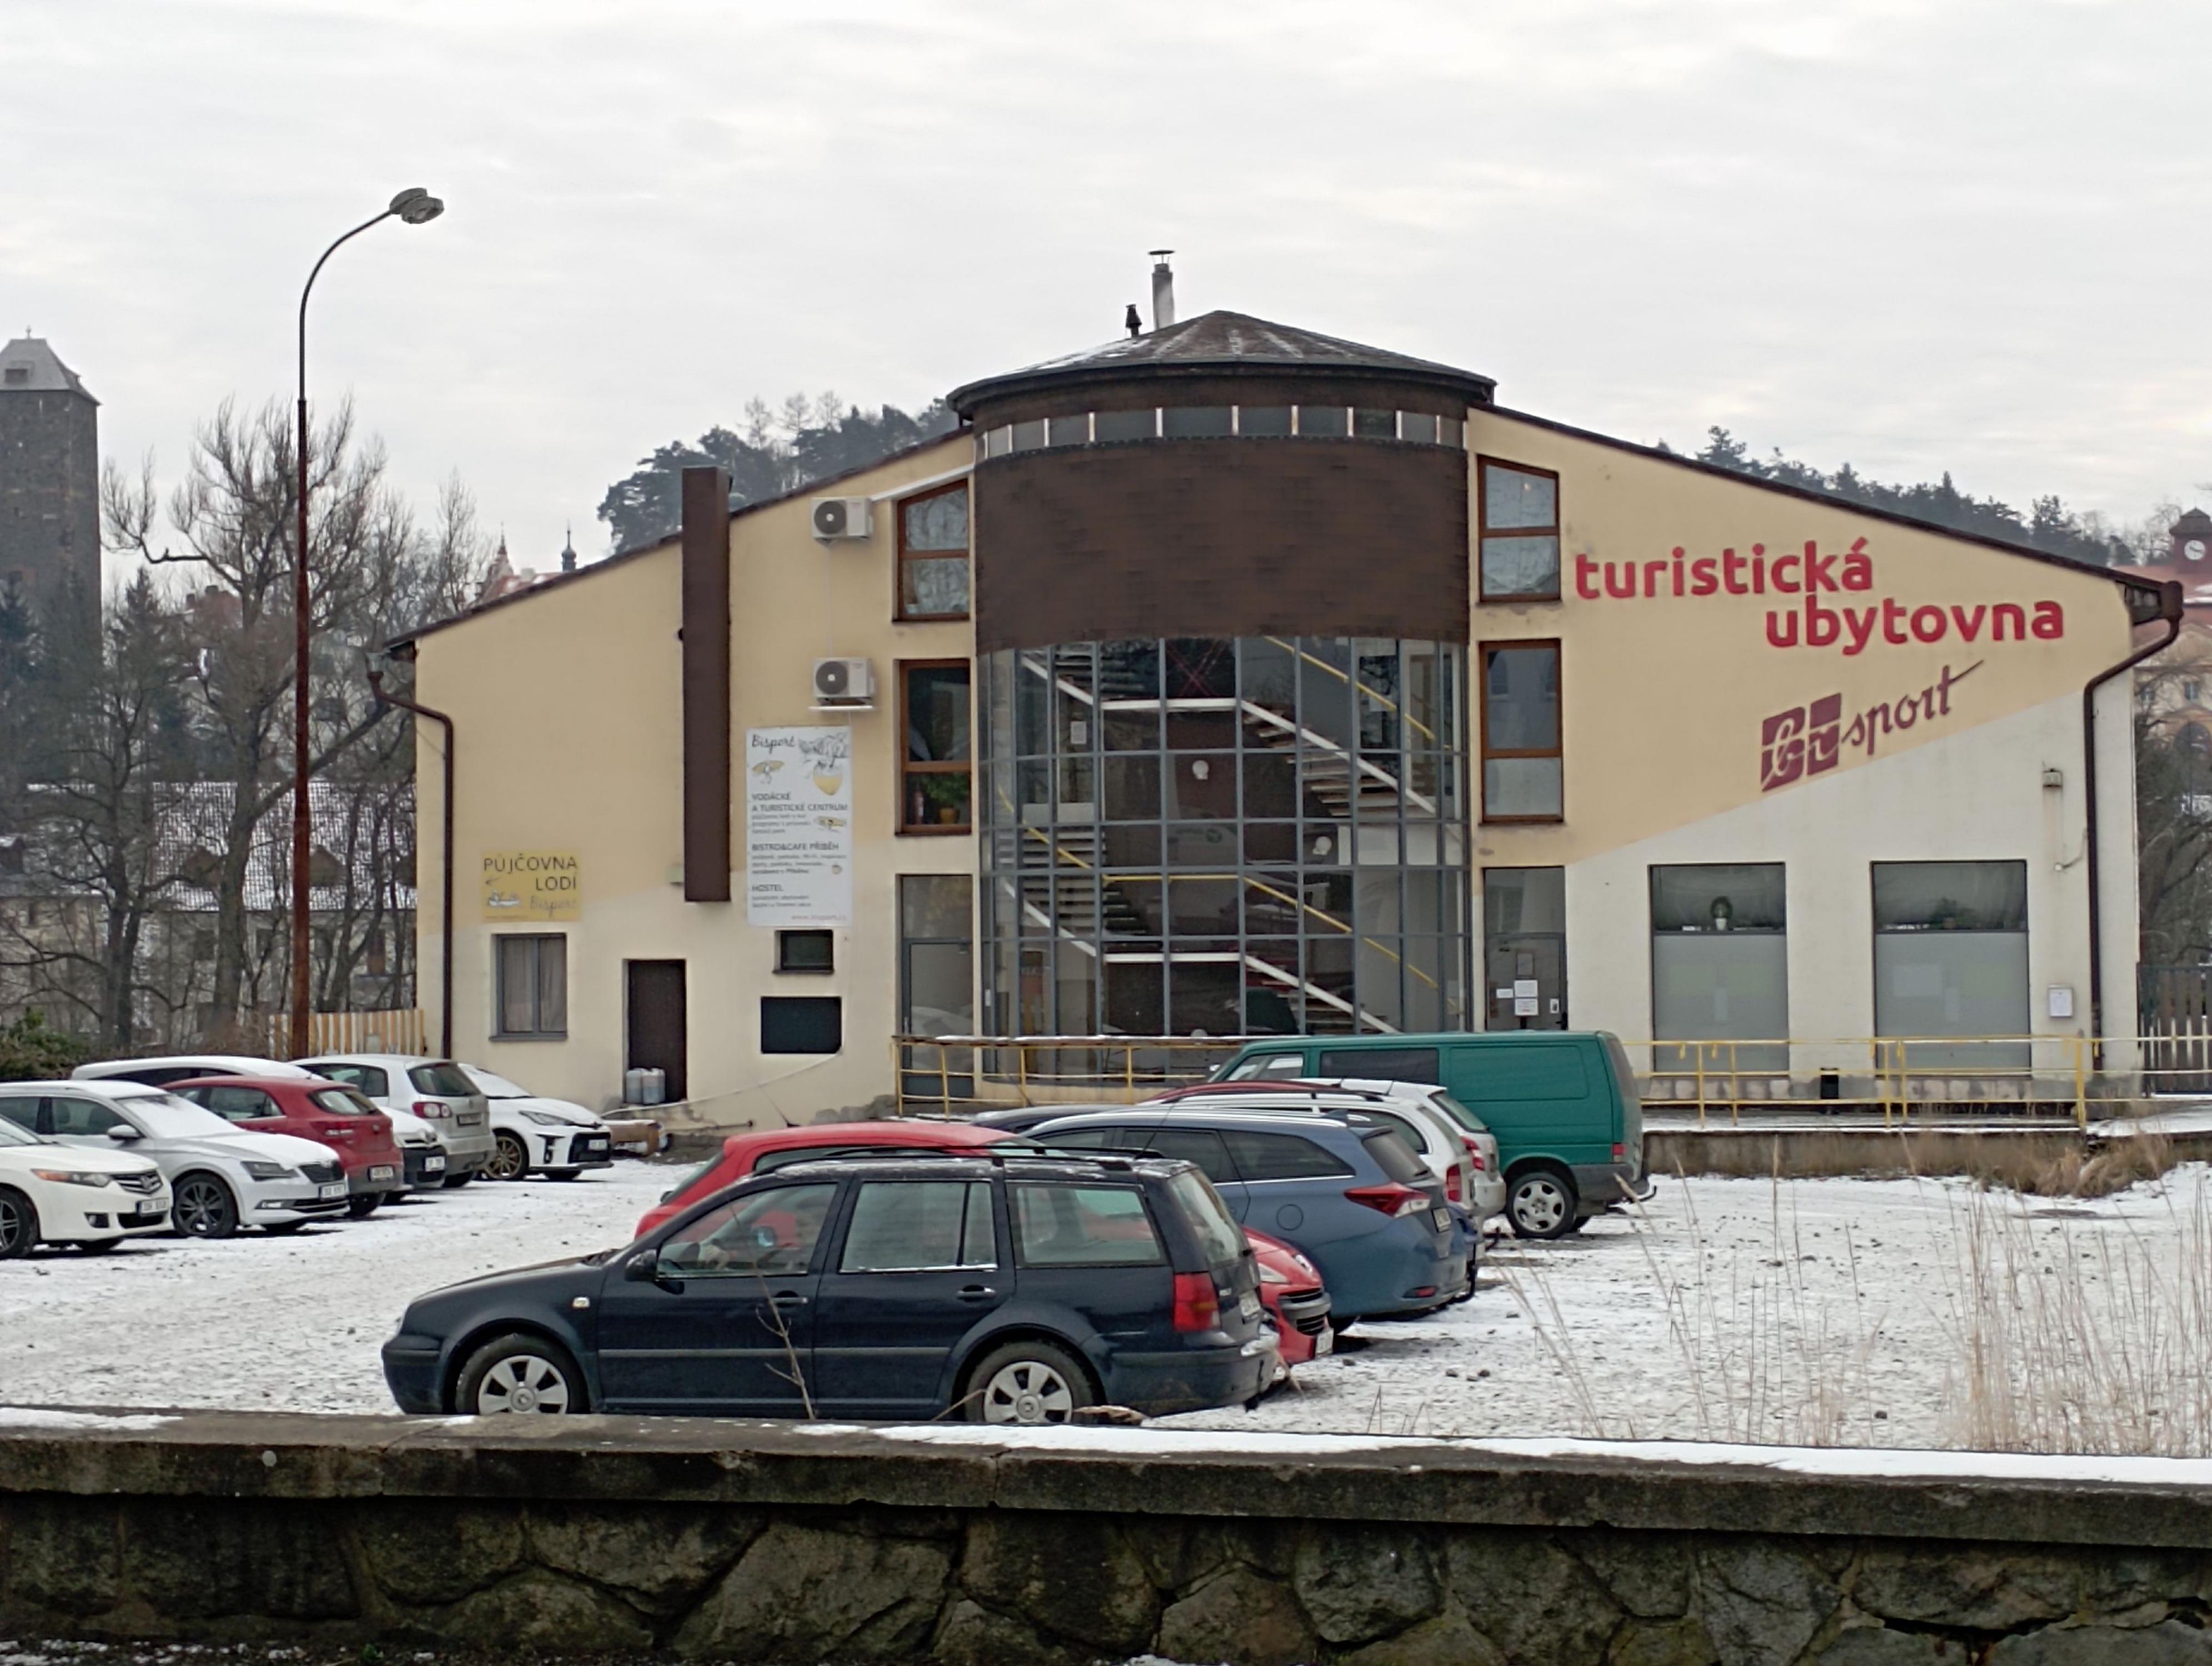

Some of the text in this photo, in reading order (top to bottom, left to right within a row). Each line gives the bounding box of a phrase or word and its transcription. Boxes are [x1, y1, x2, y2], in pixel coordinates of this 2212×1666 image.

[1575, 536, 1873, 599] turistická
[1766, 594, 2064, 656] ubytovna
[484, 854, 577, 874] PŮJČOVNA
[535, 872, 577, 891] LODÍ
